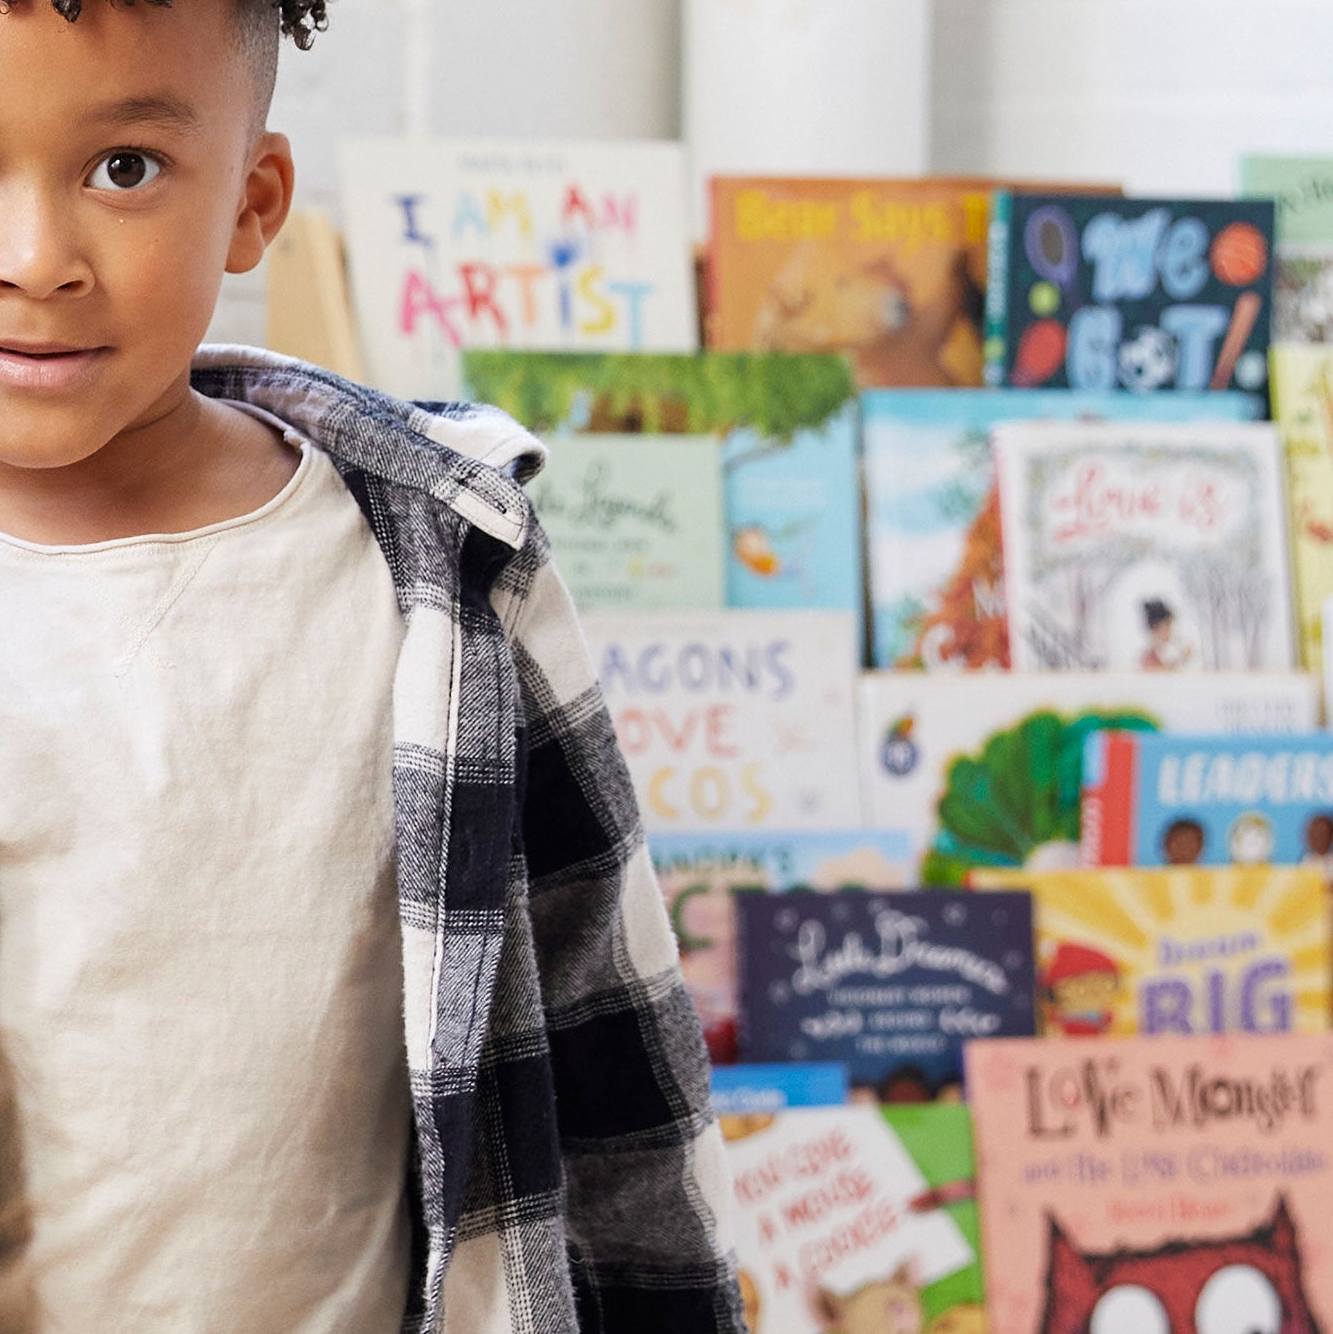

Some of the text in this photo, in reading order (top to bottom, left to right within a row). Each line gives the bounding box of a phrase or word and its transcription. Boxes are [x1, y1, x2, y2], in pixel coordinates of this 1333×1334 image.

[393, 183, 639, 249] I AM AN
[601, 641, 796, 700] AGONS
[618, 703, 739, 758] OVE
[646, 765, 773, 822] COS
